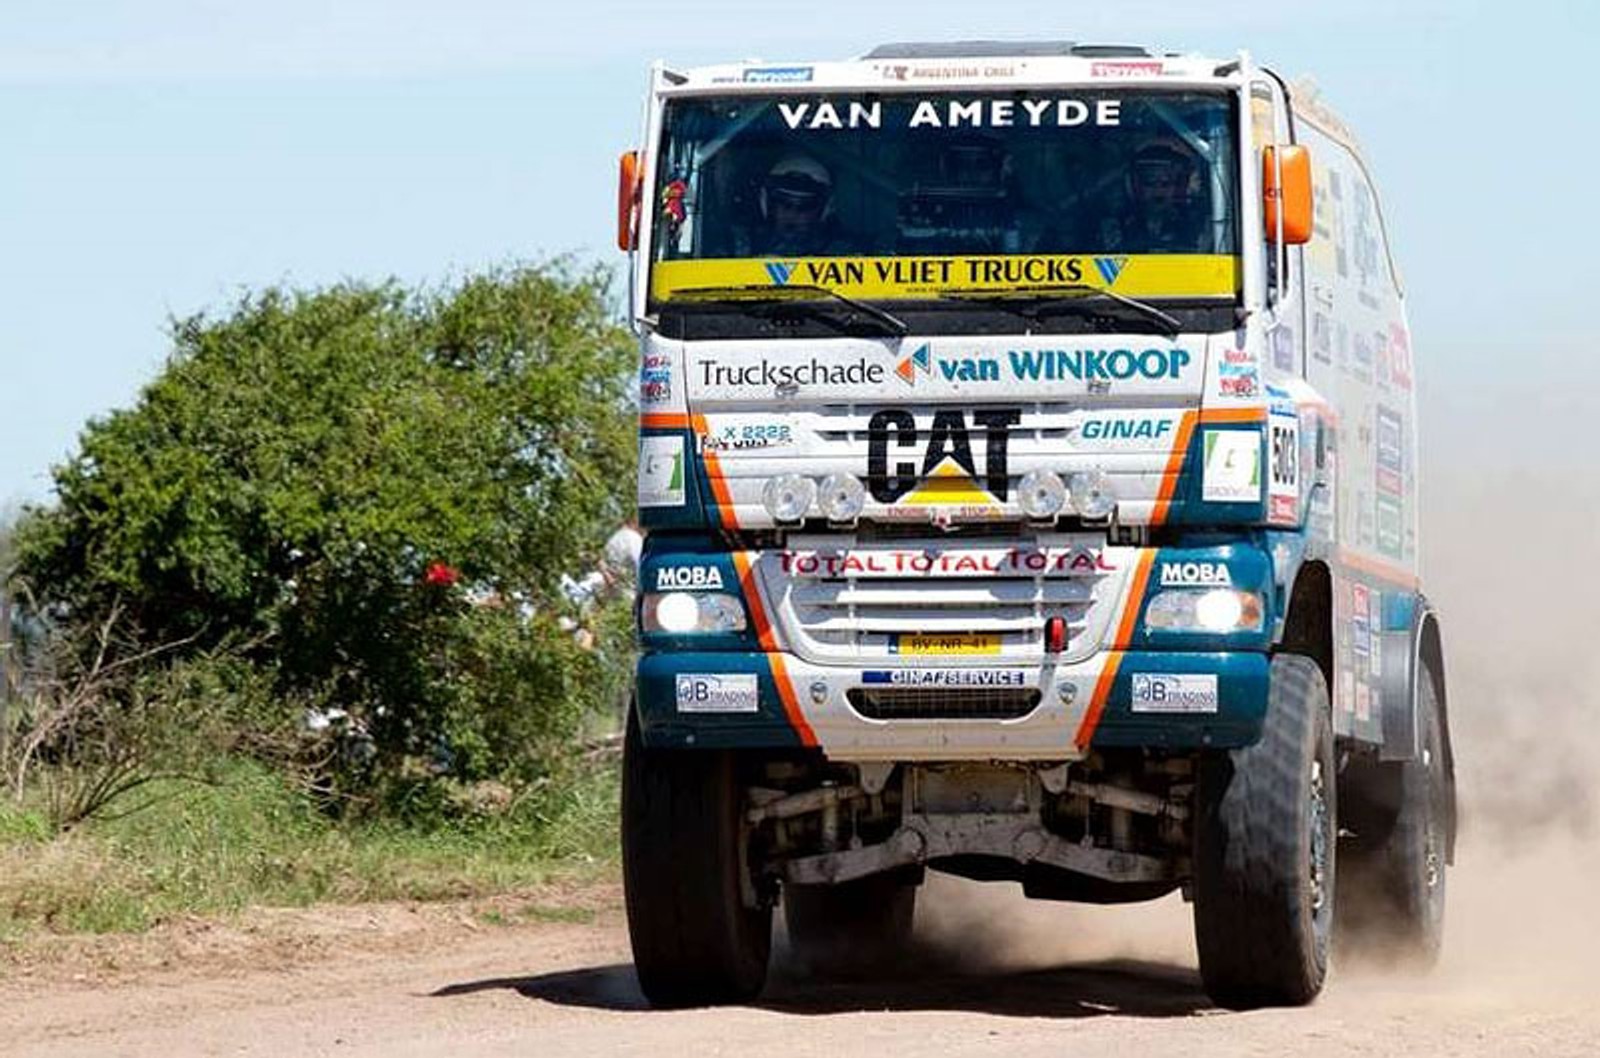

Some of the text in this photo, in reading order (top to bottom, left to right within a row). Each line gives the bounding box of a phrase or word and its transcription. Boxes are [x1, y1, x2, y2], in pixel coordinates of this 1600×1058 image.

[778, 100, 1121, 129] VAN AMEYDE
[807, 257, 1082, 285] VAN VLIET TRUCKS
[698, 358, 884, 386] Truckschade
[939, 359, 999, 381] van
[1008, 350, 1191, 381] WINKOOP
[1082, 419, 1172, 439] GINAF
[867, 408, 1021, 503] CAT
[775, 547, 1116, 573] TOTAL TOTAL TOTAL
[1162, 563, 1230, 583] MOBA
[657, 567, 722, 587] MOBA
[945, 671, 1024, 685] SERVICE
